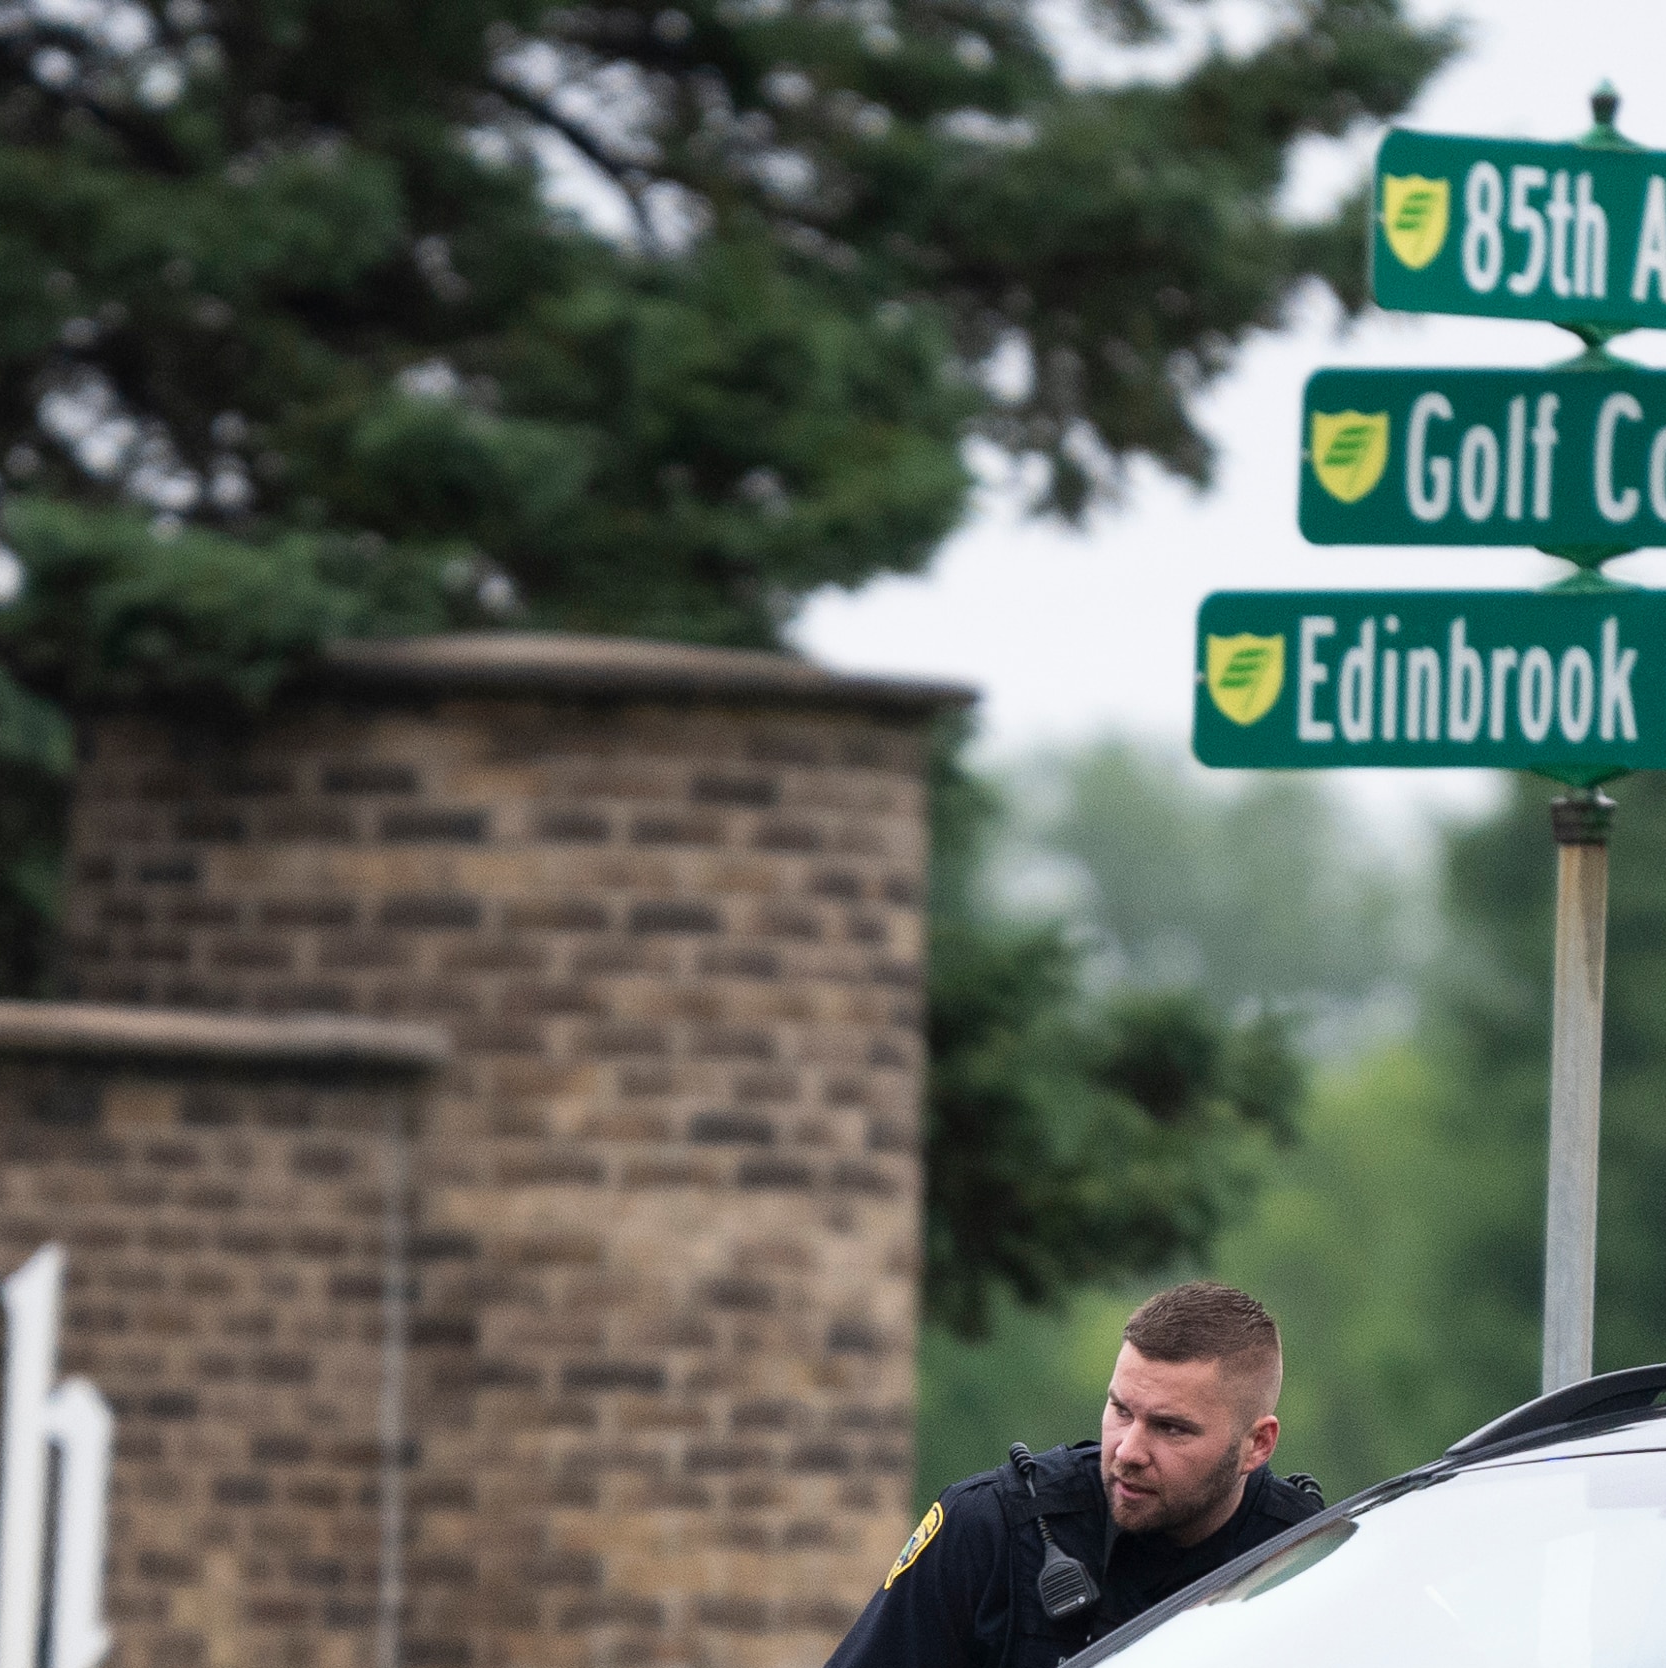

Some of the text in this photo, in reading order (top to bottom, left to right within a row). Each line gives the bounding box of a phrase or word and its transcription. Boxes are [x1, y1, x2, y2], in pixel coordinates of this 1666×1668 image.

[1462, 160, 1610, 301] 85th
[1405, 391, 1560, 522] Golf
[1297, 616, 1638, 744] Edinbrook
